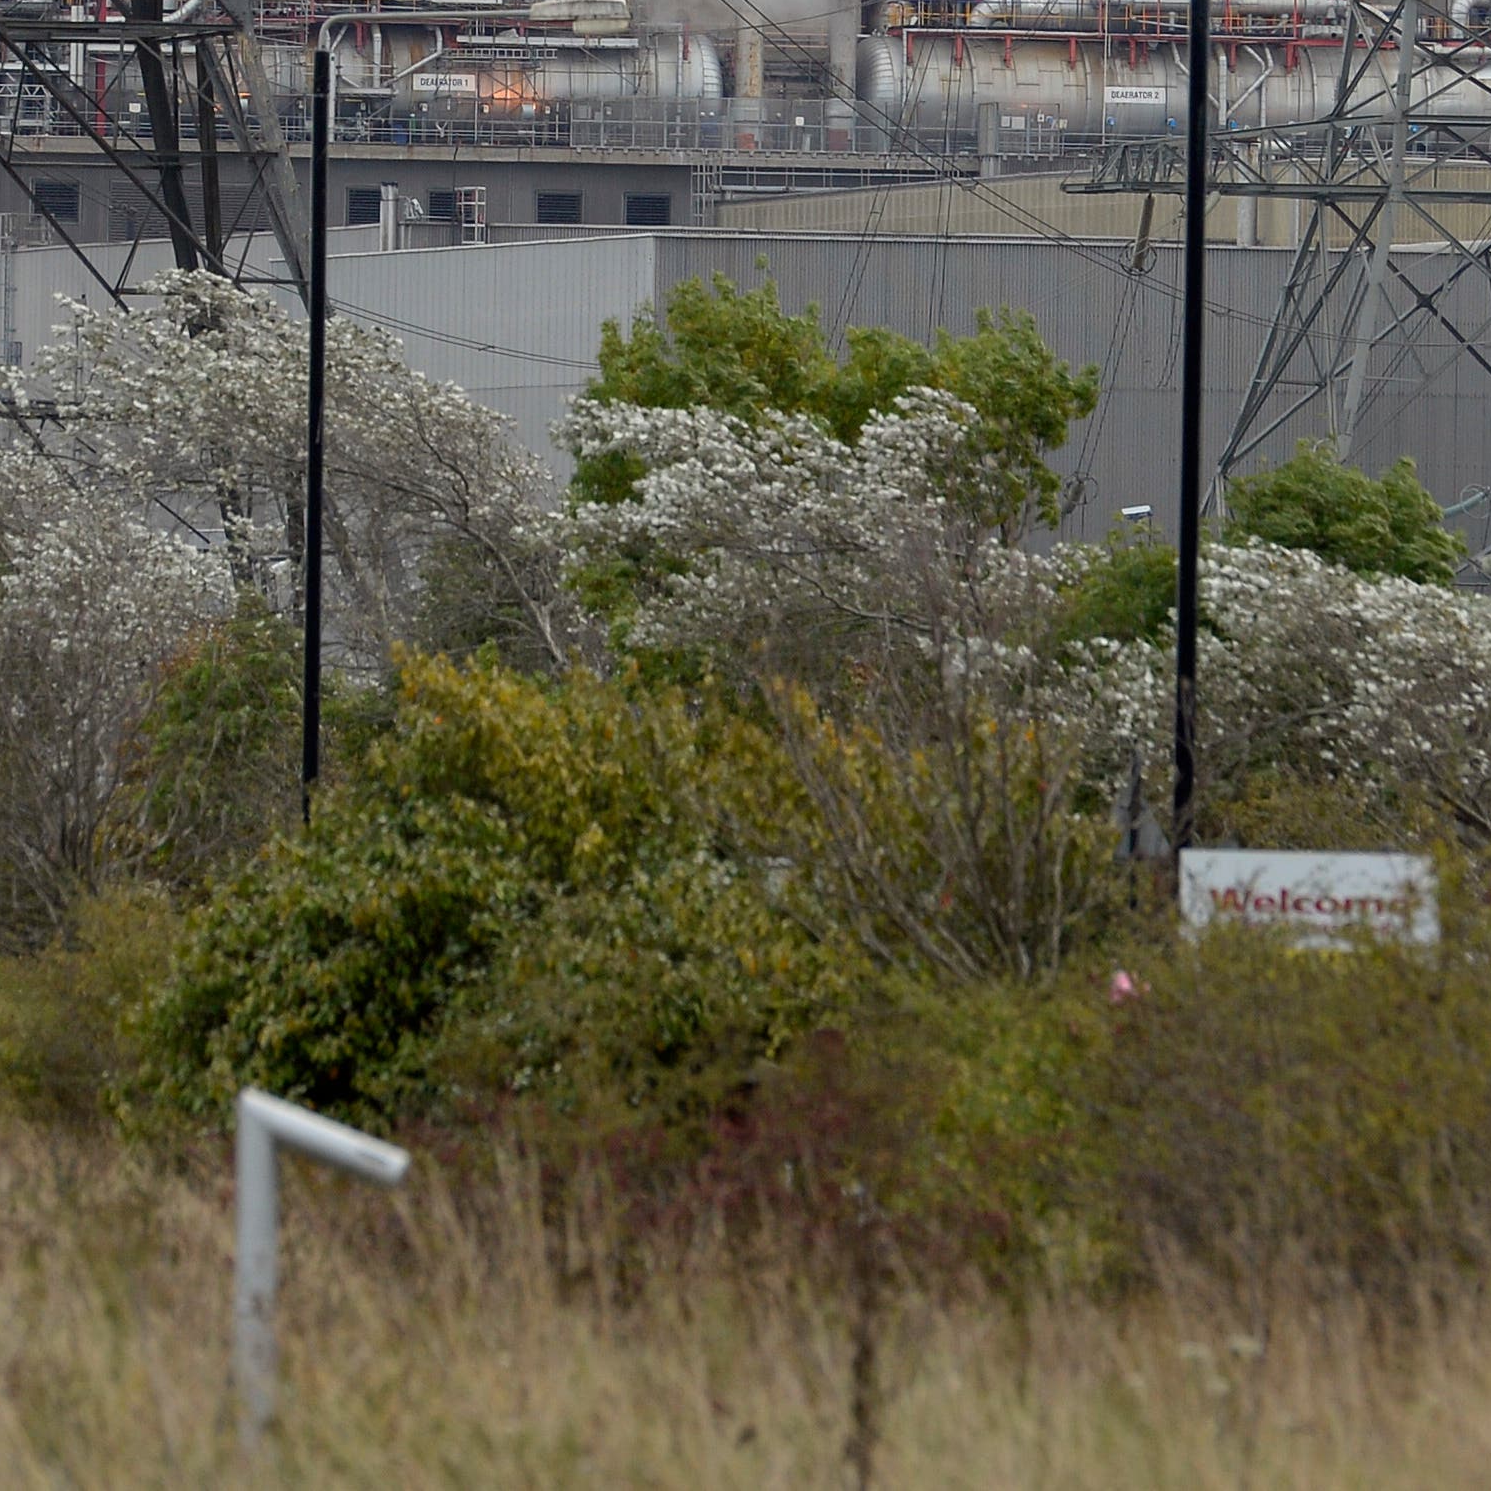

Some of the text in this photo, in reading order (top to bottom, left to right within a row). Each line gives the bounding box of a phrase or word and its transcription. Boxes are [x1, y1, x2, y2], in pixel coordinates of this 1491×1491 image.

[464, 78, 469, 86] 1
[1111, 90, 1160, 99] DEAERATOR 2
